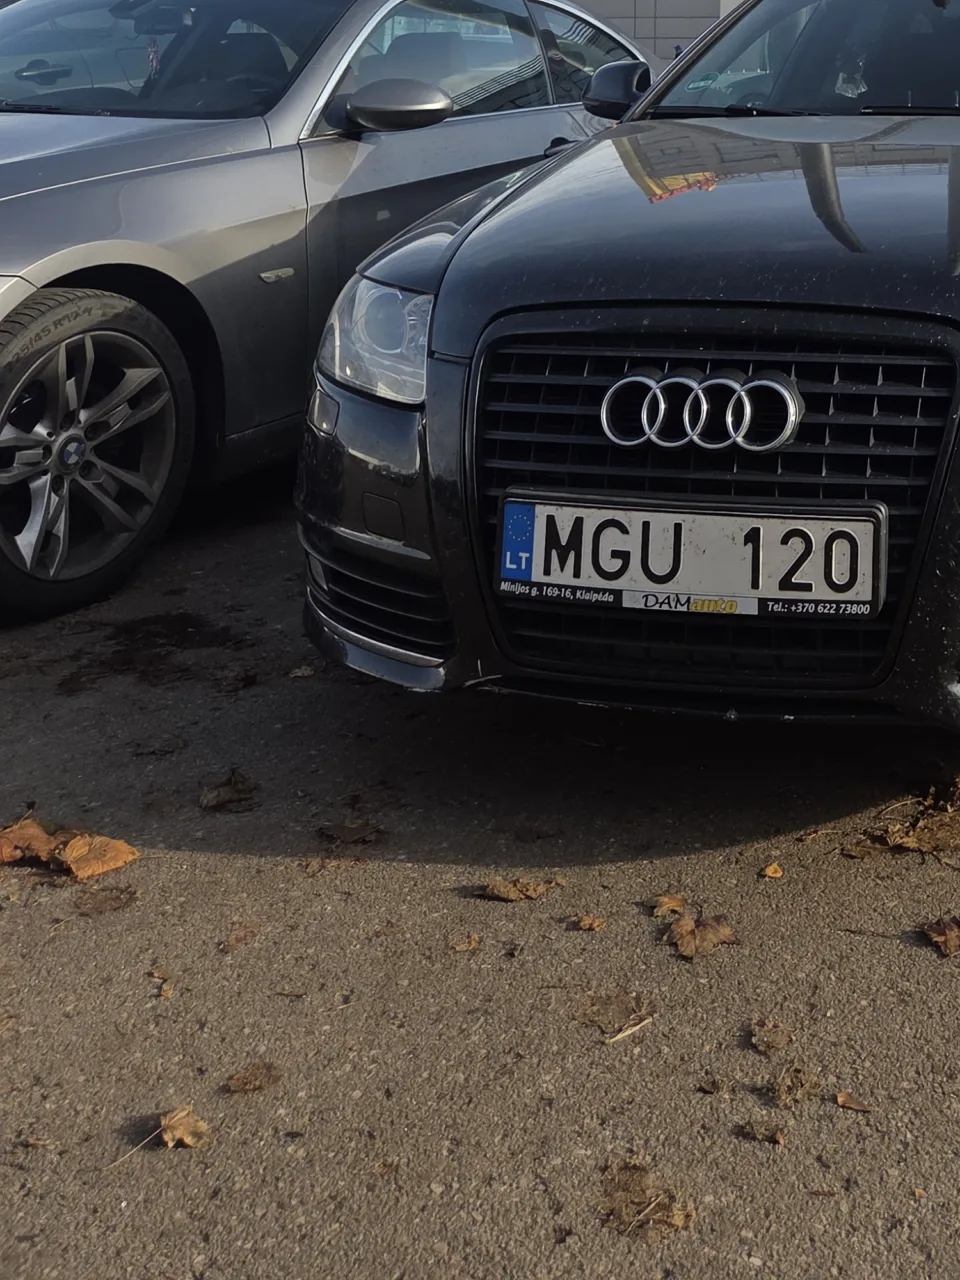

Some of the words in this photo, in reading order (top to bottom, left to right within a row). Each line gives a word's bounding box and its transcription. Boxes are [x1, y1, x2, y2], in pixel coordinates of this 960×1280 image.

[506, 552, 530, 570] LT
[543, 513, 683, 585] MGU
[743, 525, 860, 595] 120
[500, 581, 530, 594] Minijos
[531, 586, 540, 597] g.
[767, 601, 788, 613] Tel.:
[790, 602, 816, 613] +370
[817, 603, 837, 614] 622
[839, 603, 871, 615] 73800
